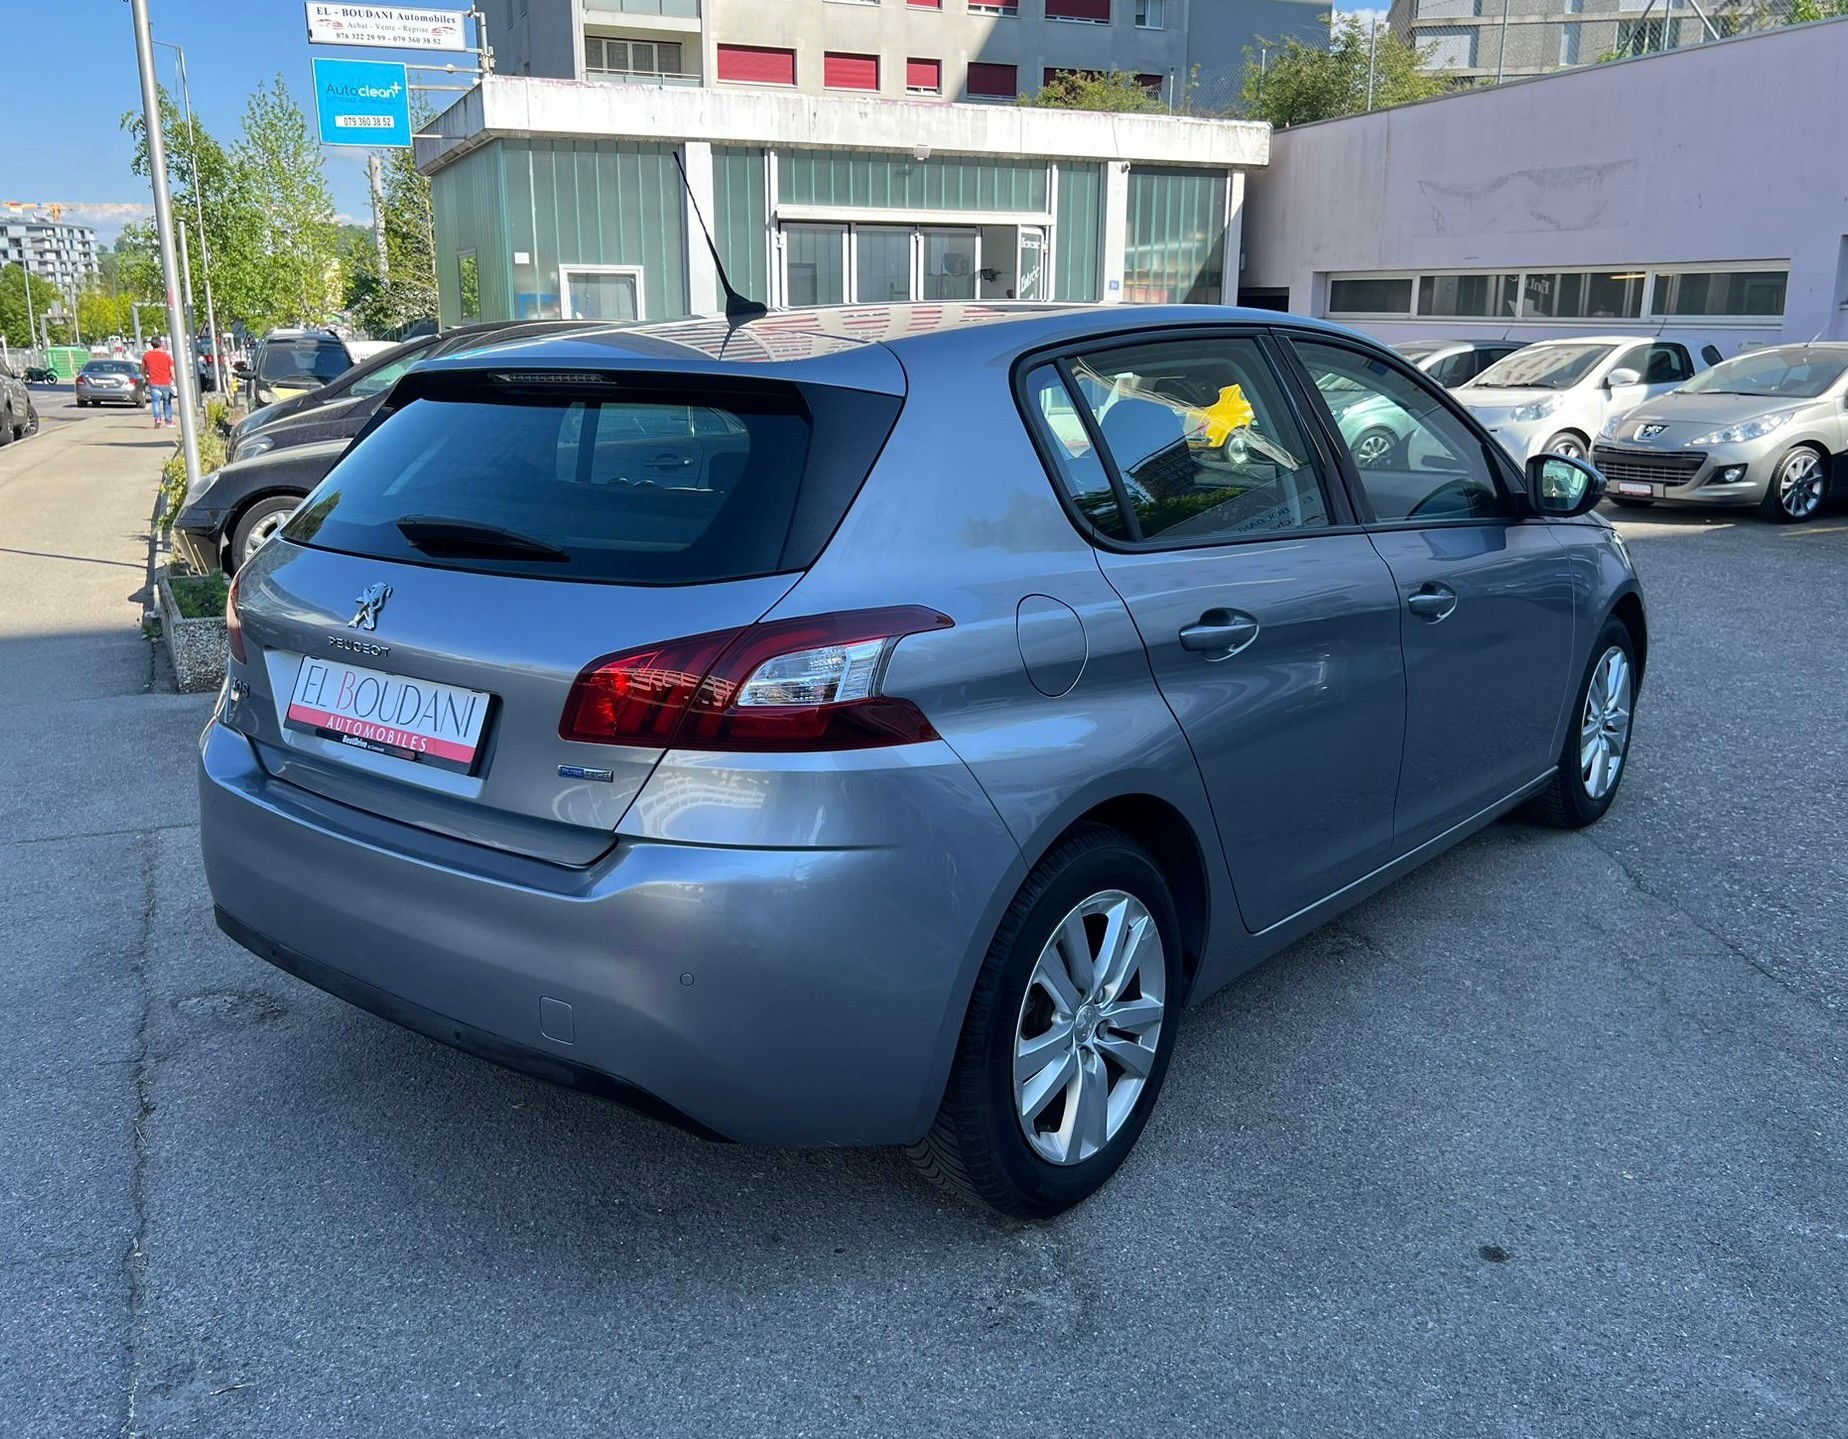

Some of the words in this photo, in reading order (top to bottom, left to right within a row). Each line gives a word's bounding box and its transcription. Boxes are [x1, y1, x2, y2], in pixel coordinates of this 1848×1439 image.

[317, 7, 331, 16] EL
[342, 8, 393, 20] BOUDANI
[397, 12, 456, 24] Automobiles
[347, 22, 368, 30] Achat
[375, 23, 396, 31] Vente
[403, 25, 429, 34] Reprise
[343, 117, 357, 126] 079
[358, 117, 371, 126] 360
[372, 117, 381, 126] 38
[382, 117, 391, 126] 52
[328, 635, 391, 658] PEUGEOT
[301, 665, 328, 708] EL
[336, 671, 477, 738] BOUDANI
[326, 716, 427, 752] AUTOMOBILES
